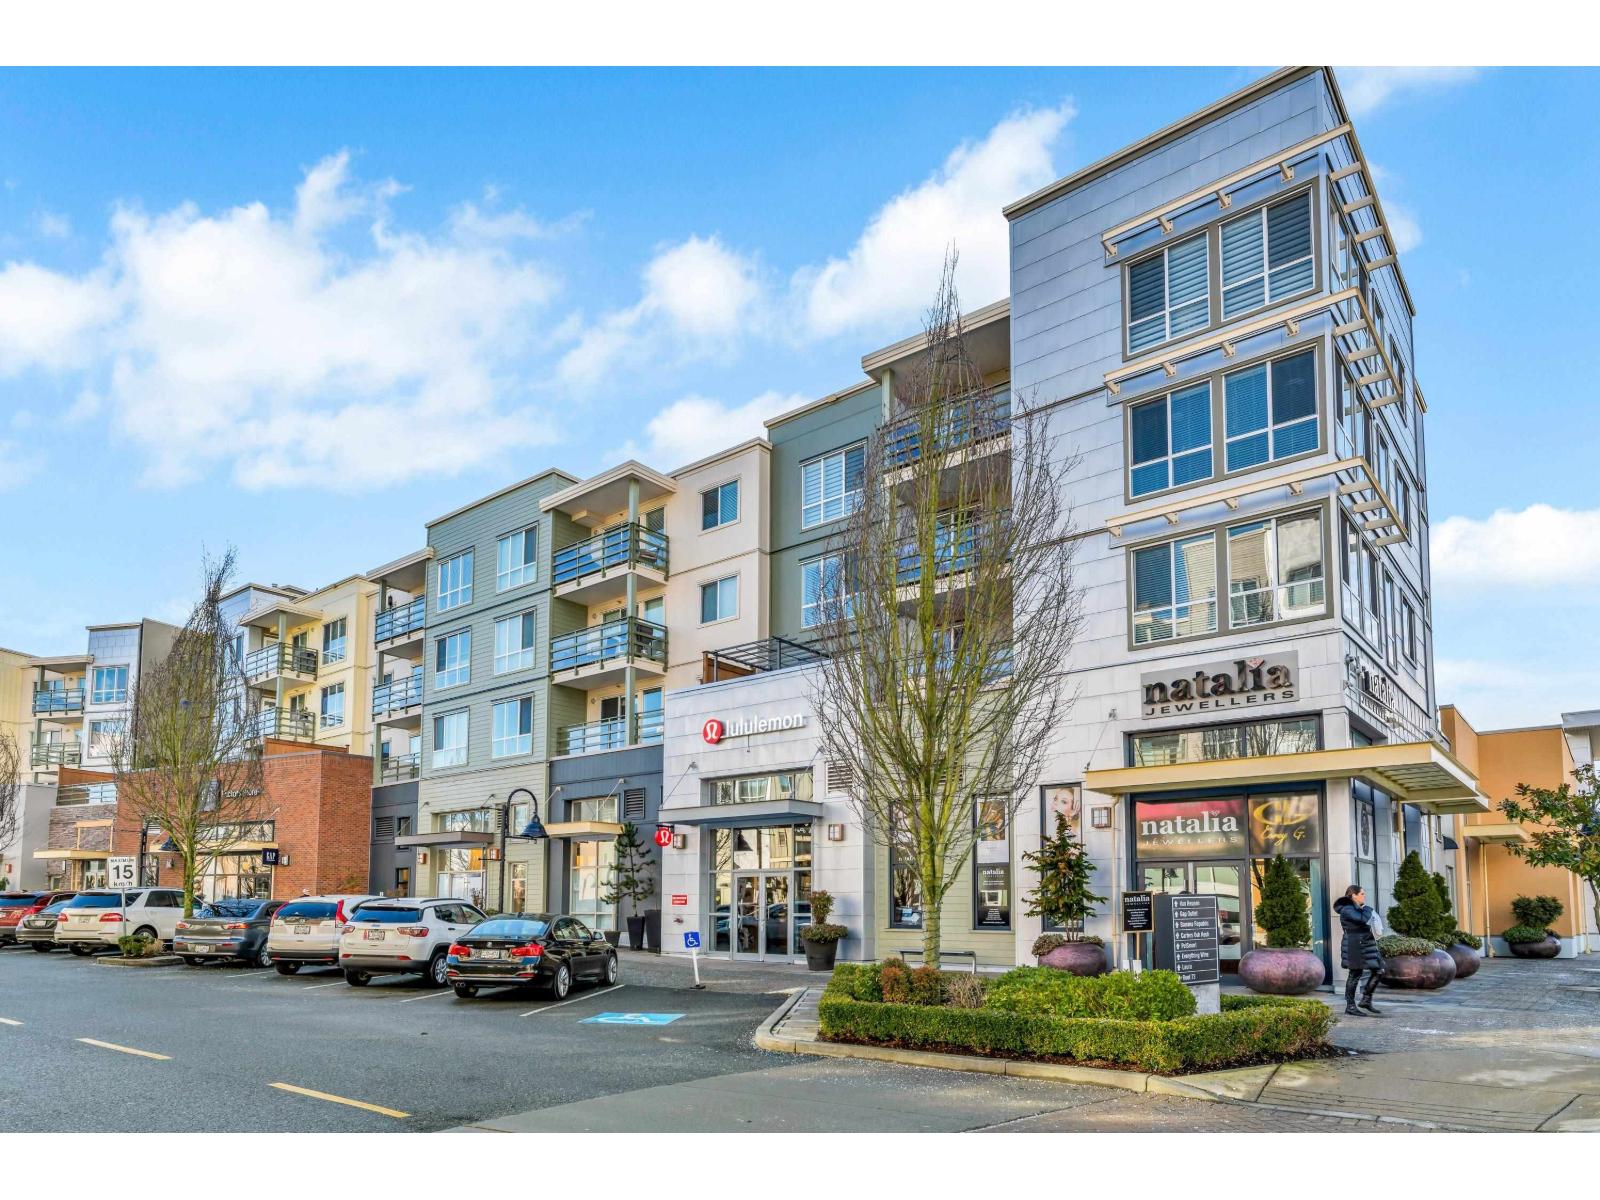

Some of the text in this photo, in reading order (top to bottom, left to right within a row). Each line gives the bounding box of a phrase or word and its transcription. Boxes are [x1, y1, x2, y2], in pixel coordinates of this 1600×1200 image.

[1143, 657, 1293, 705] natalia
[1145, 690, 1295, 716] JEWELLERS
[725, 712, 804, 737] lululemon
[1141, 810, 1239, 836] natalia
[112, 864, 134, 880] 15
[1124, 894, 1150, 903] natalia
